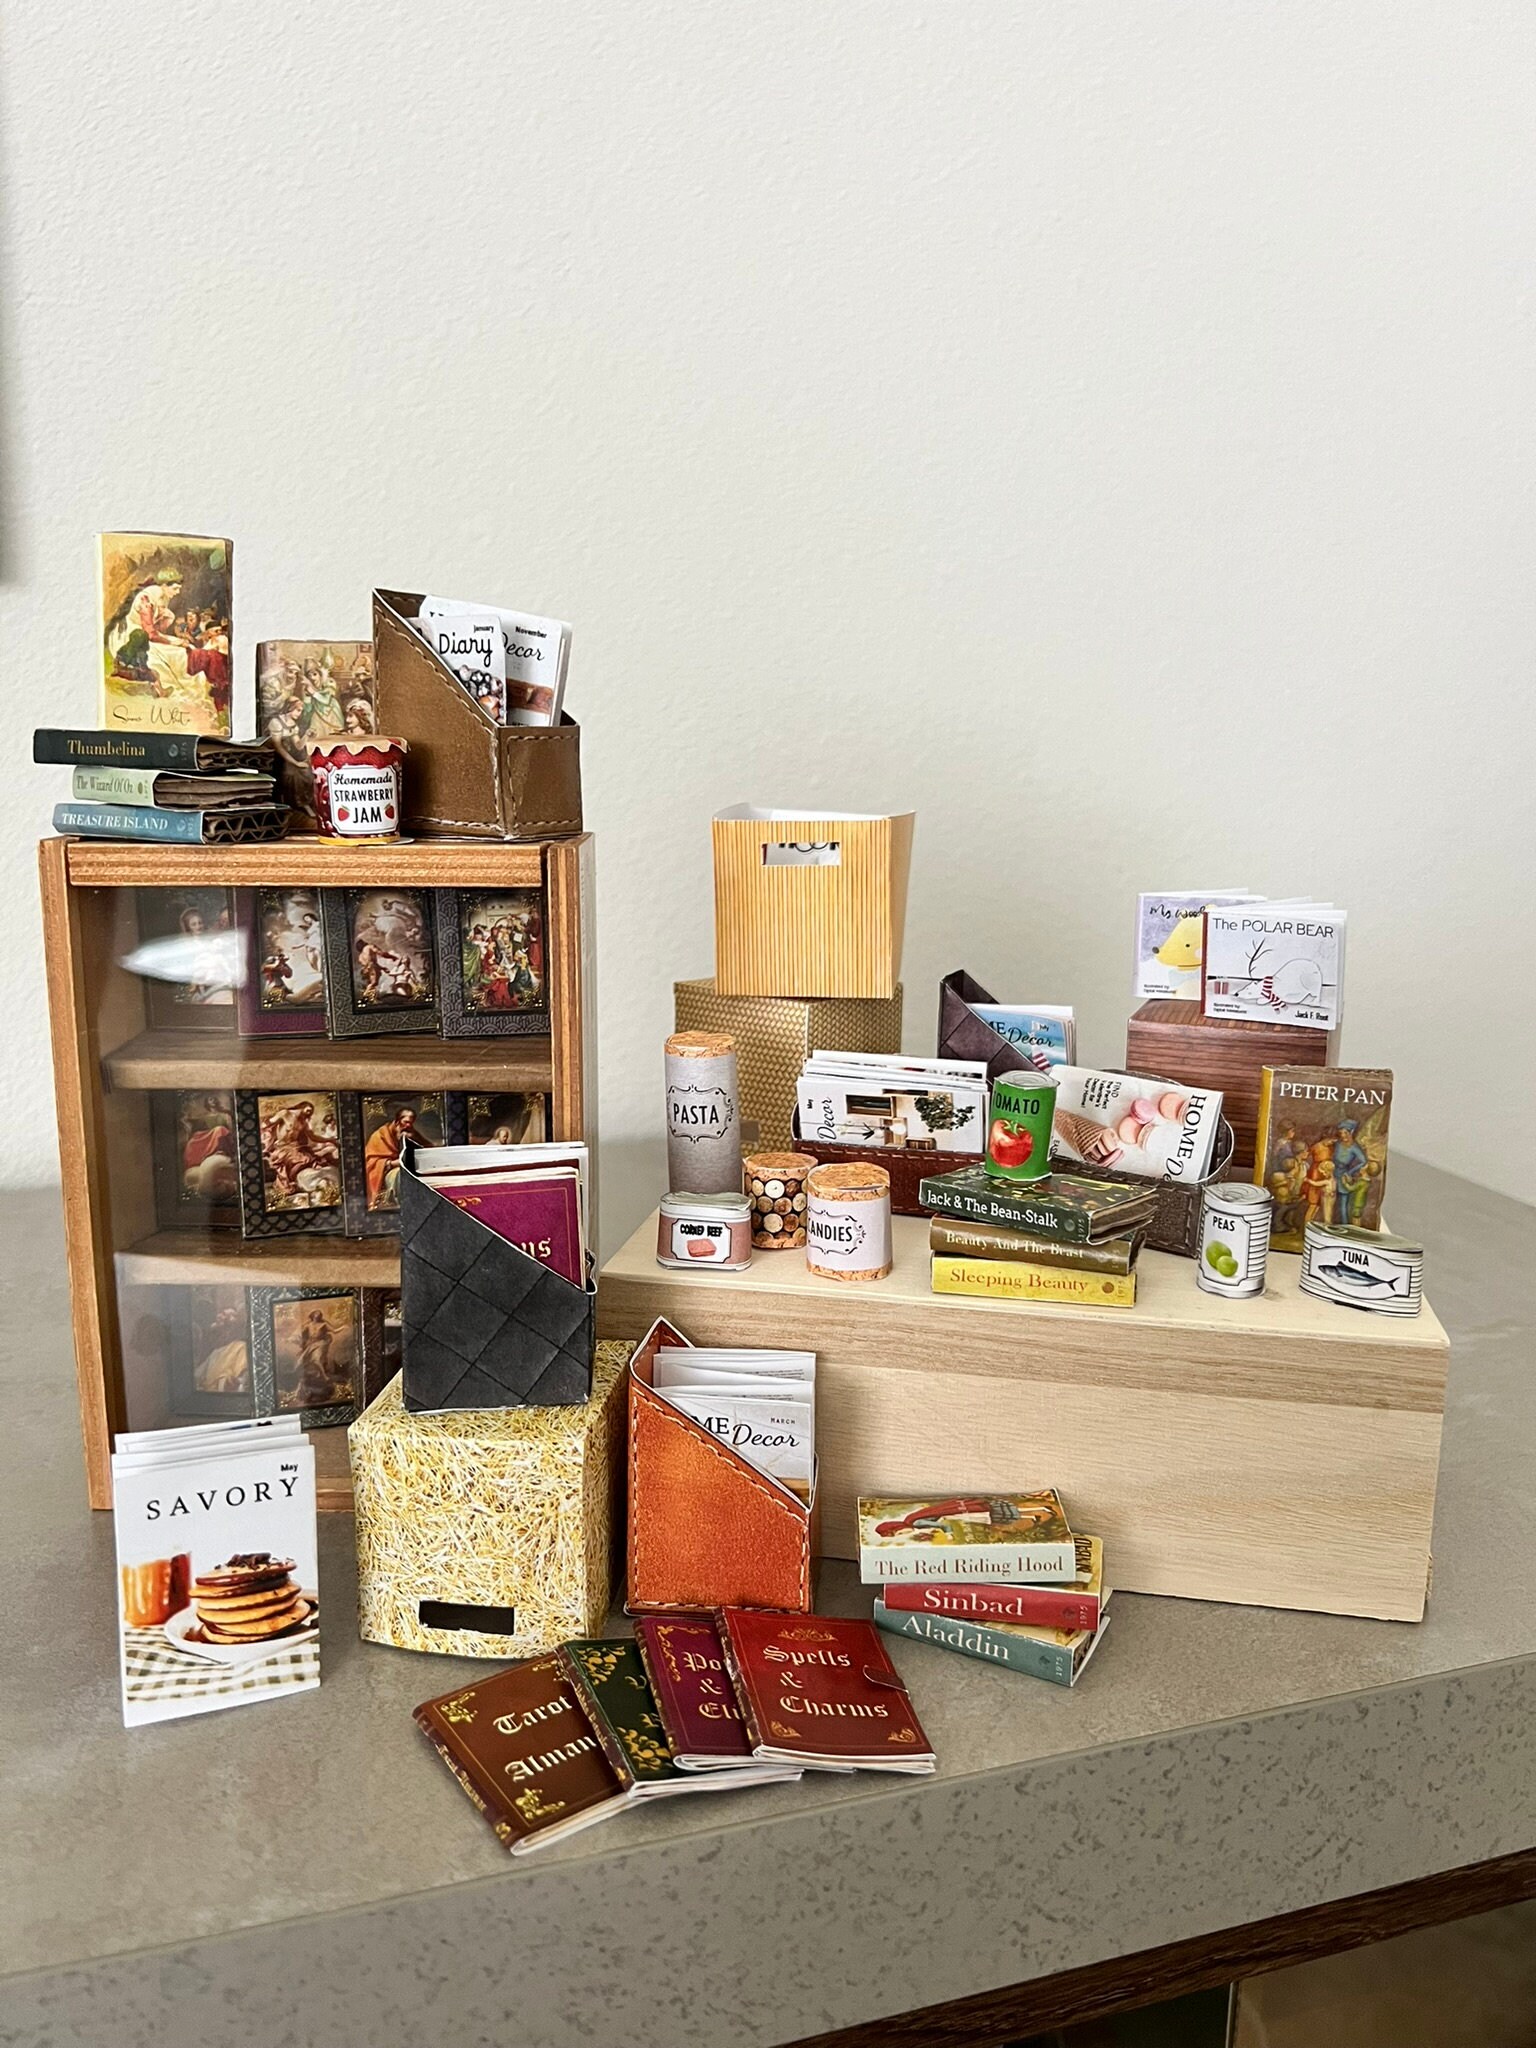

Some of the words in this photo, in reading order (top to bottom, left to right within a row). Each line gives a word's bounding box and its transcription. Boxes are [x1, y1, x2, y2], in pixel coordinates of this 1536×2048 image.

[515, 626, 548, 639] November
[438, 631, 494, 667] Diary
[67, 739, 146, 757] Thumbelina
[333, 771, 393, 785] Homemade
[333, 788, 394, 802] STRAWBERRY
[61, 812, 122, 829] TREASURE
[123, 816, 168, 831] ISLAND
[352, 806, 383, 824] JAM
[1212, 917, 1239, 931] The
[1242, 919, 1293, 935] POLAR
[1296, 922, 1335, 938] BEAR
[1007, 1026, 1056, 1048] Decor
[1279, 1081, 1339, 1102] PETER
[1343, 1087, 1386, 1106] PAN
[672, 1102, 720, 1125] PASTA
[816, 1095, 837, 1140] Decor
[1177, 1094, 1207, 1159] HOME
[927, 1189, 951, 1207] Jack
[953, 1194, 963, 1210] &
[964, 1197, 988, 1214] The
[990, 1202, 1059, 1229] Bean-Stalk
[1211, 1214, 1236, 1232] PEAS
[945, 1231, 988, 1250] Beauty
[993, 1237, 1019, 1251] And
[1023, 1240, 1047, 1255] The
[1050, 1242, 1084, 1258] Beast
[1342, 1250, 1370, 1267] TUNA
[949, 1268, 1023, 1289] Sleeping
[1028, 1273, 1089, 1293] Beauty
[770, 1417, 796, 1425] MARCH
[732, 1423, 801, 1447] Decor
[280, 1463, 299, 1473] May
[146, 1476, 299, 1521] SAVORY
[875, 1560, 908, 1576] The
[914, 1559, 948, 1575] Red
[954, 1557, 1012, 1577] Riding
[1017, 1556, 1063, 1572] Hood
[923, 1587, 1025, 1617] Sinbad
[901, 1614, 1011, 1661] Aladdin
[762, 1644, 852, 1667] Spells
[779, 1670, 804, 1689] &
[492, 1694, 574, 1735] Tarot
[779, 1695, 890, 1719] Charms
